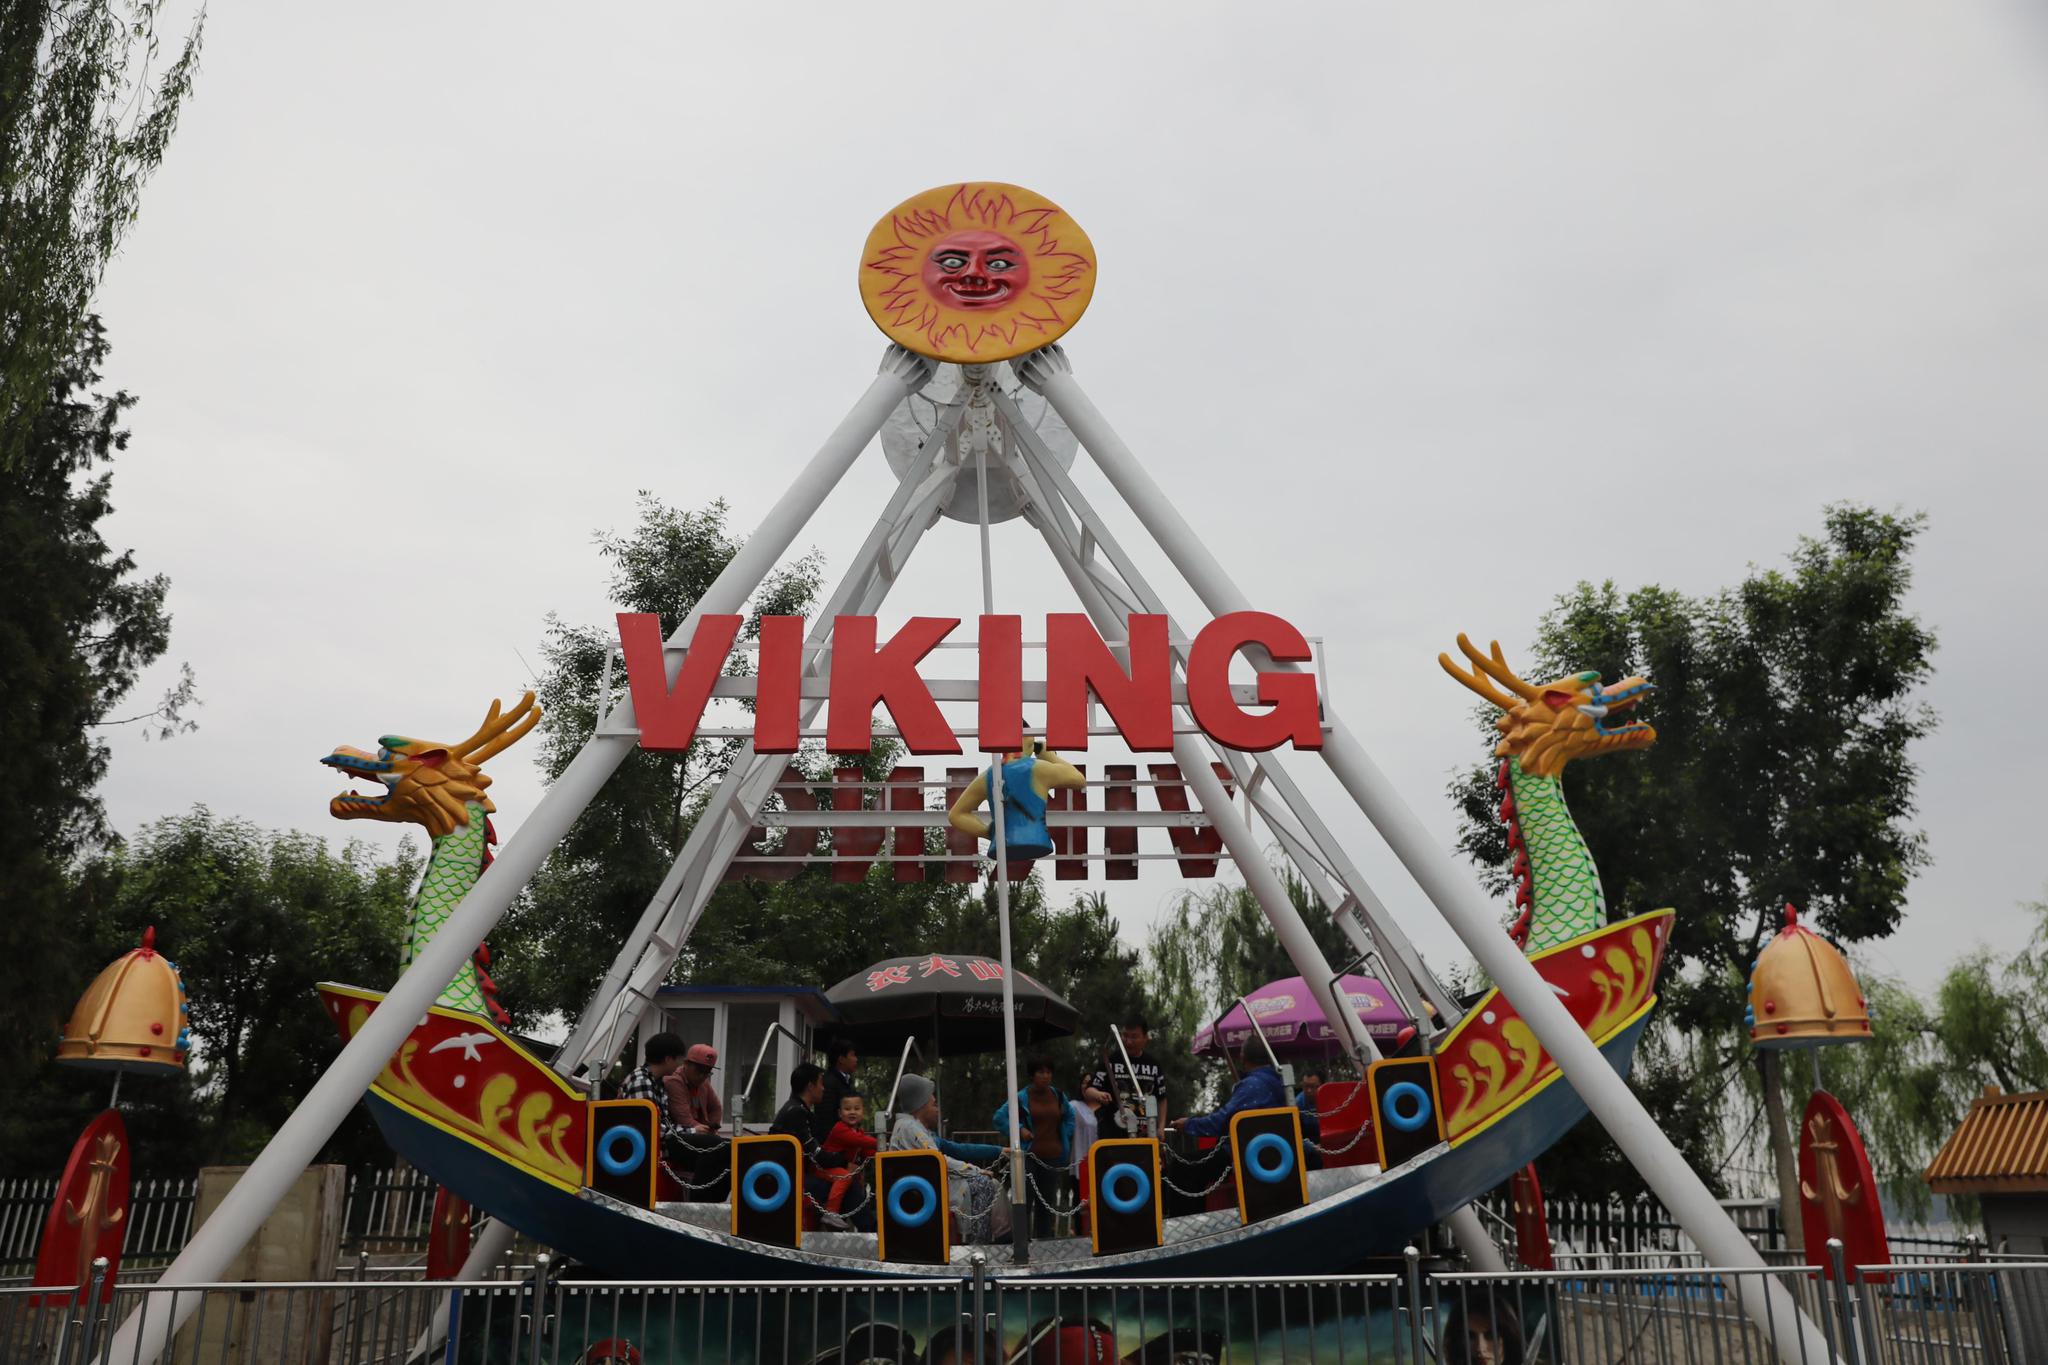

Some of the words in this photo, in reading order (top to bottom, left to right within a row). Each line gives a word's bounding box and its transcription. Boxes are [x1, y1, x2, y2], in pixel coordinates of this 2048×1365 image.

[615, 610, 1323, 755] VIKING
[865, 954, 1046, 992] 农夫山
